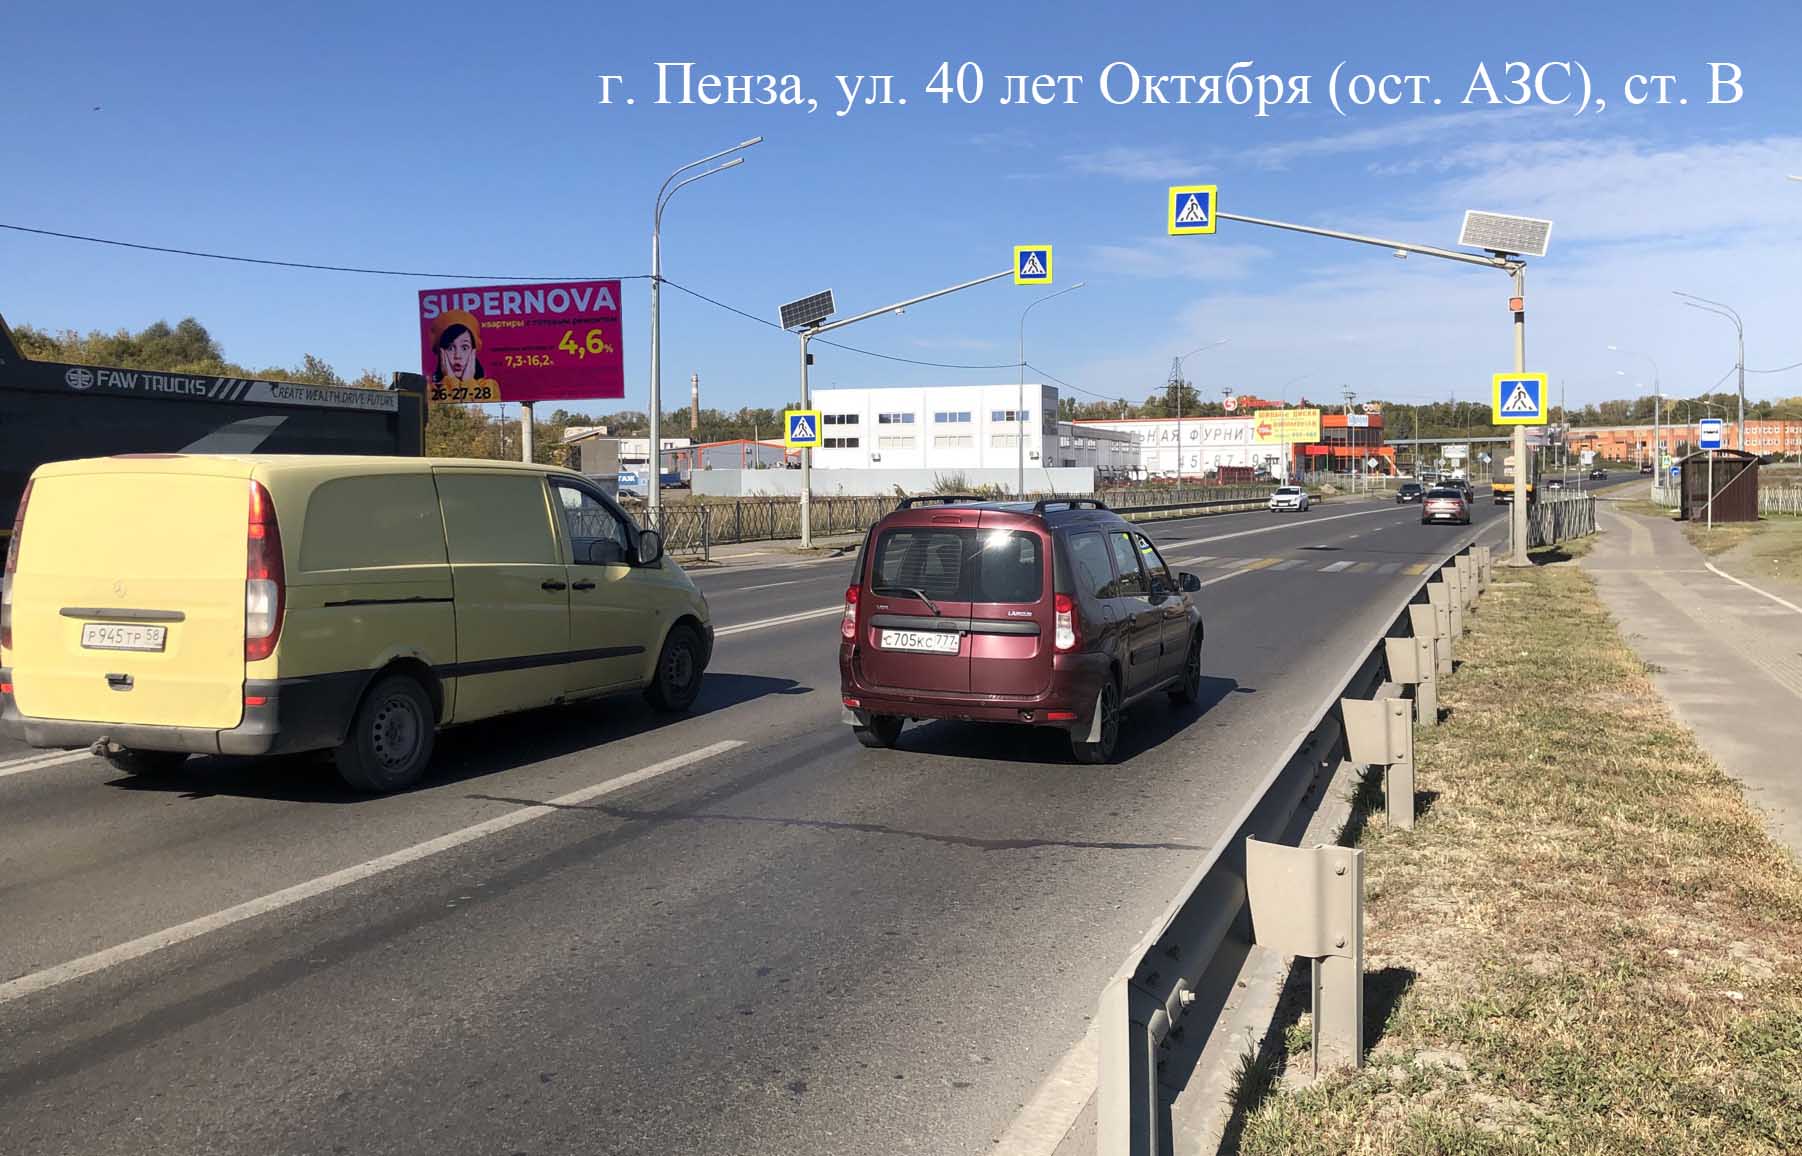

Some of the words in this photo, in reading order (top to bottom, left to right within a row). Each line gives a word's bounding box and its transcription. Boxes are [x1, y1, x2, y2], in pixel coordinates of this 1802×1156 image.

[422, 286, 617, 319] SUPERNOVA
[96, 369, 138, 390] FAW
[142, 374, 206, 396] TRUCKS
[431, 386, 492, 401] 26-27-28
